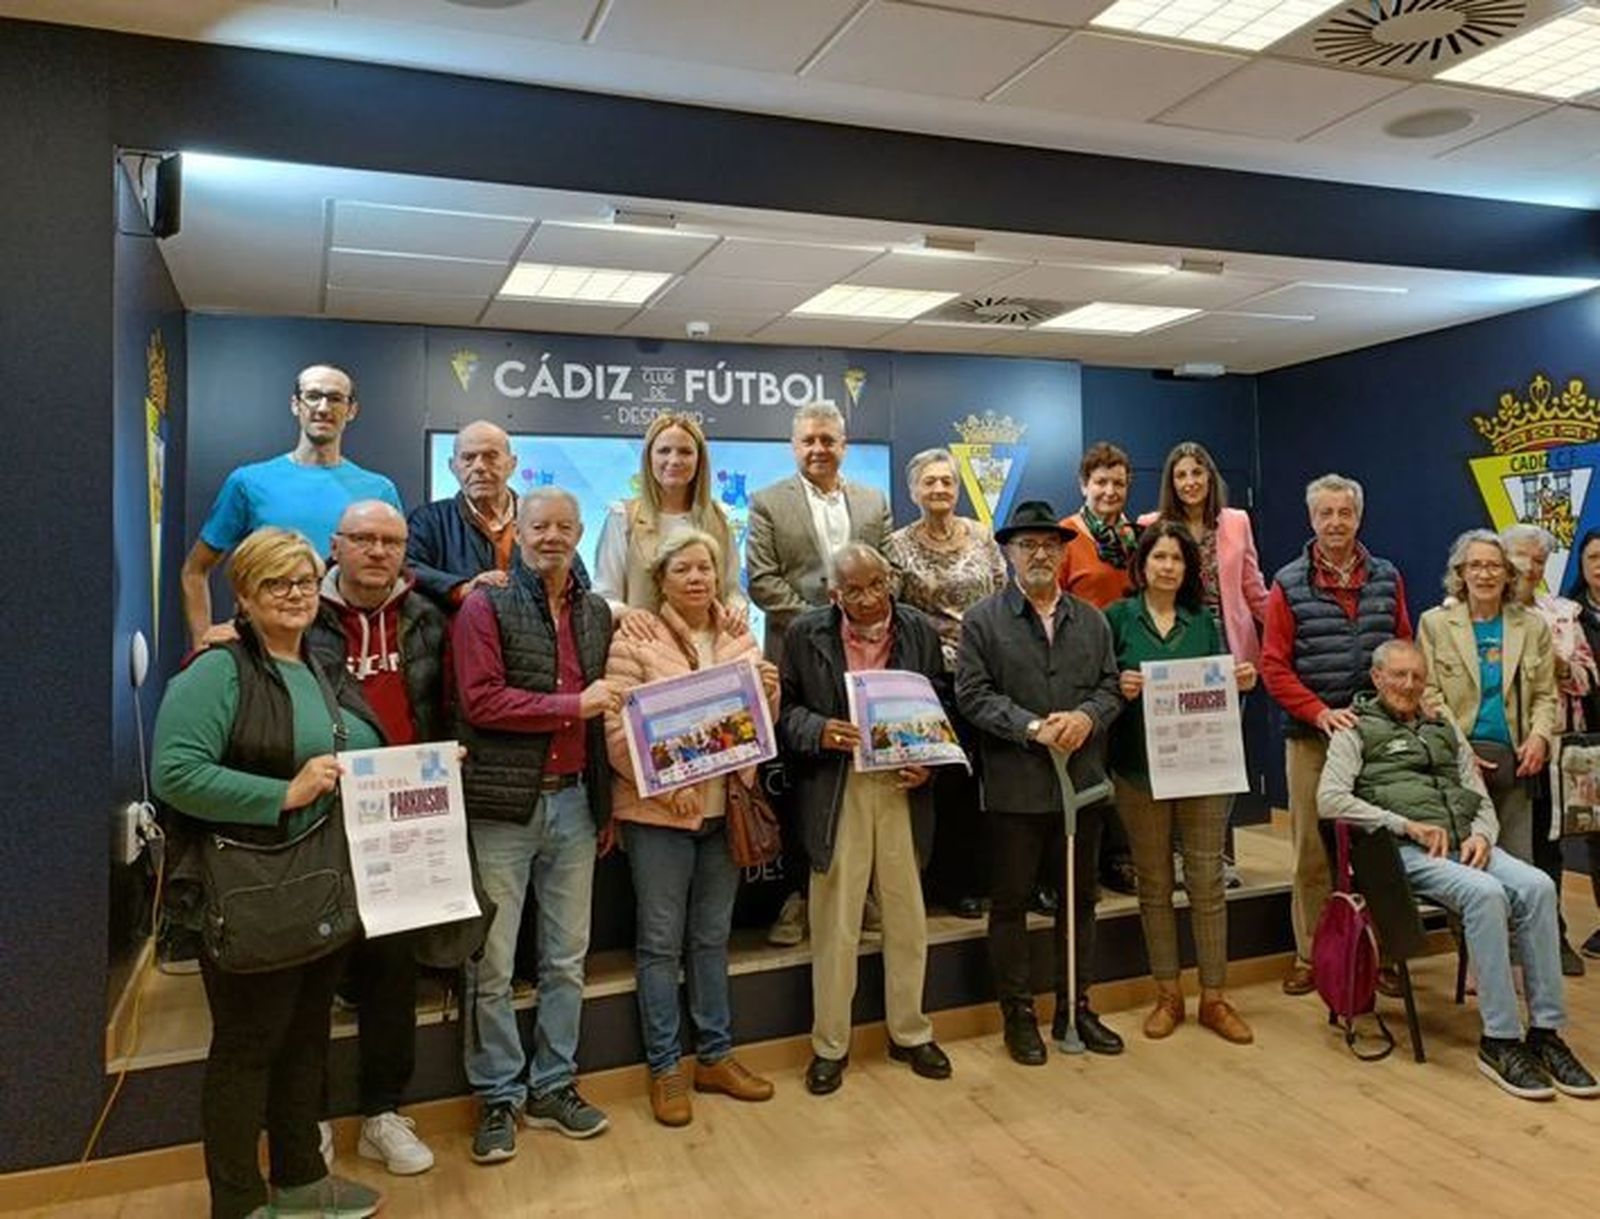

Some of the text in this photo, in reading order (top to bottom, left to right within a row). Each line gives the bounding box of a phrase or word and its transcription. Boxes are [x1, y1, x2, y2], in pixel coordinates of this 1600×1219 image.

[494, 353, 633, 400] CÁDIZ
[685, 361, 836, 407] FÚTBOL
[1510, 452, 1550, 472] CADIZ
